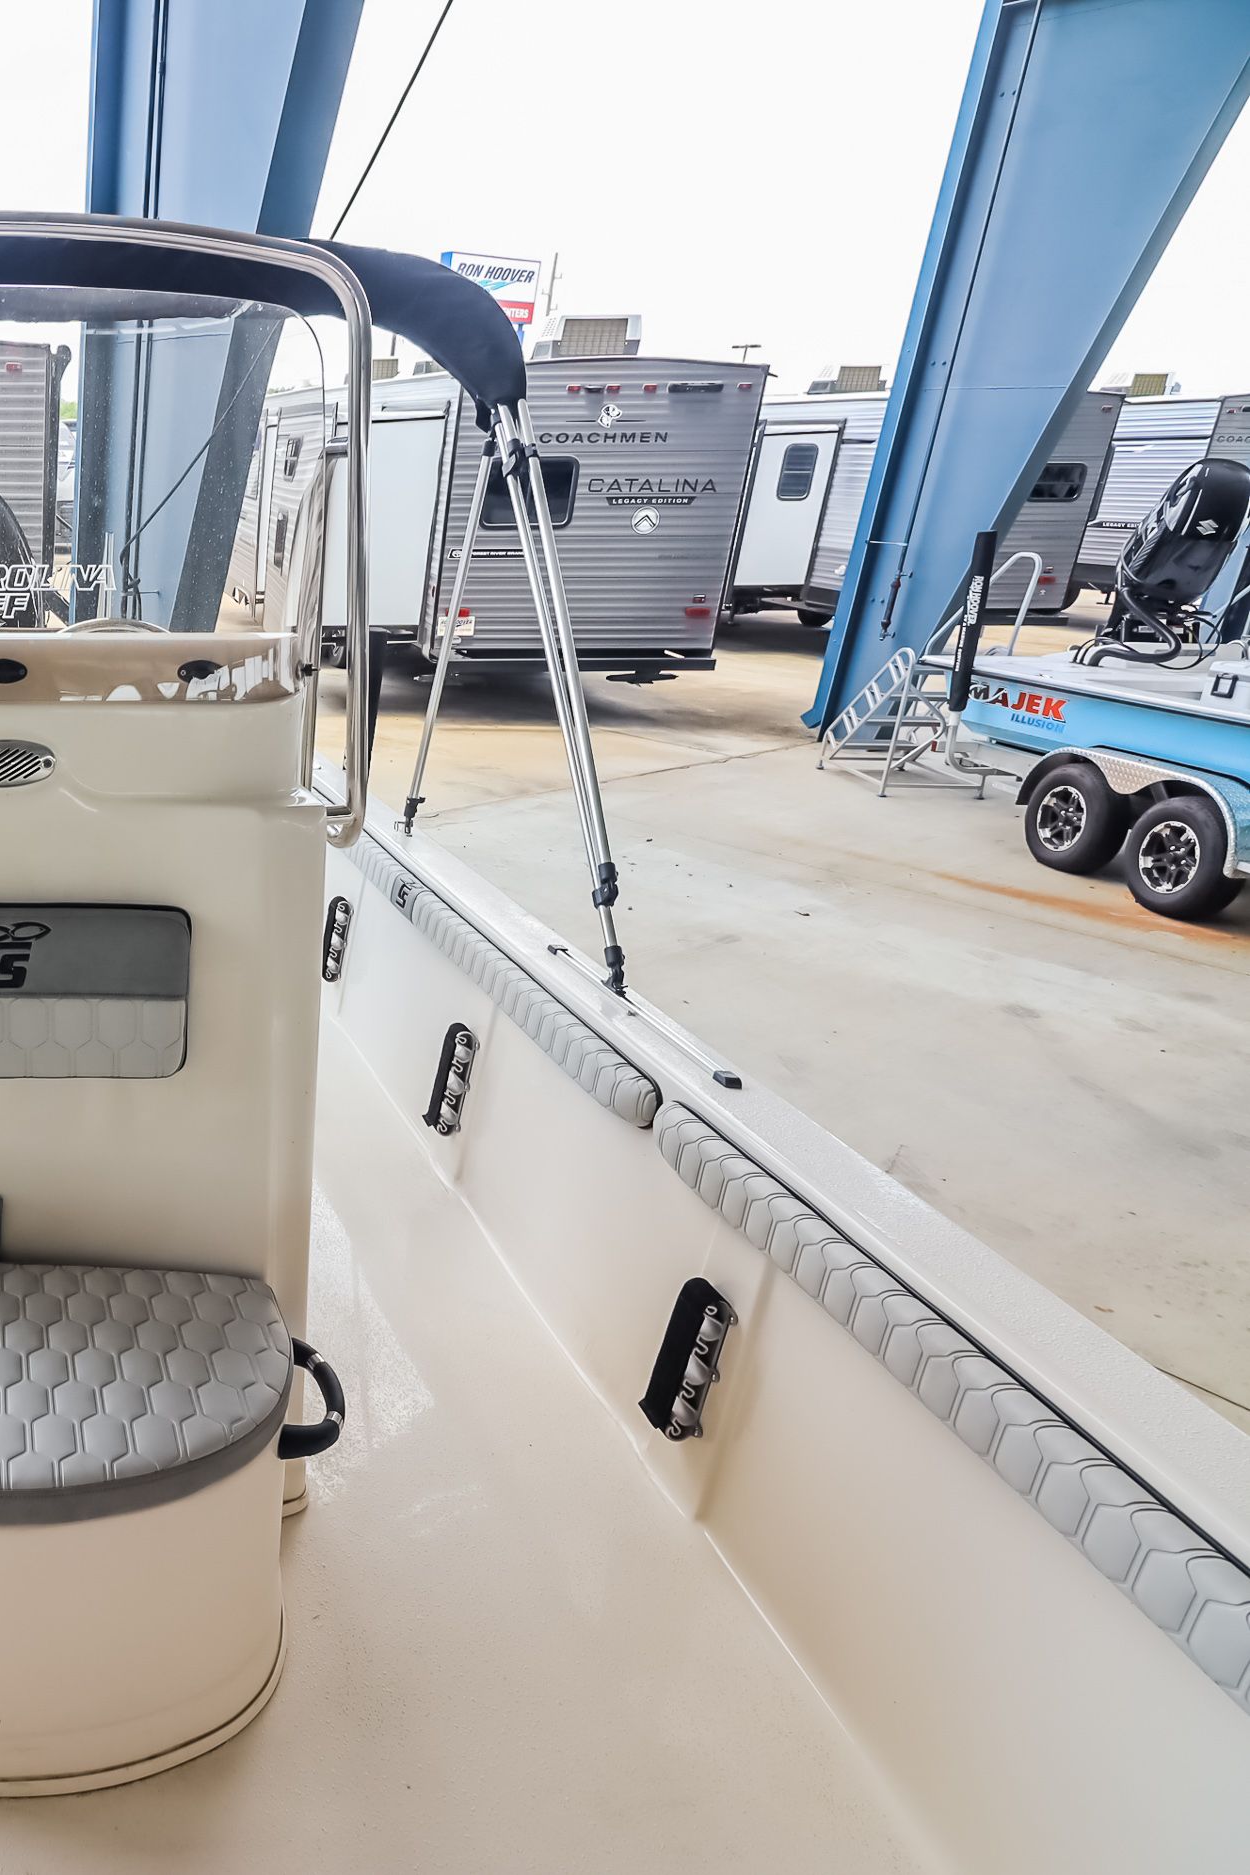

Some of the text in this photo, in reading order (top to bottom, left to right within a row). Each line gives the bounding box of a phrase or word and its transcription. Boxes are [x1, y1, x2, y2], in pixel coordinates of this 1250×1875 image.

[457, 262, 535, 283] RON HOOVER
[539, 432, 668, 443] COACHMEN
[1216, 435, 1250, 443] COAC
[588, 478, 717, 493] CATALINA
[969, 575, 985, 625] RON HOOVER
[970, 681, 1068, 722] MAJEK
[1011, 713, 1066, 734] ILLUSION
